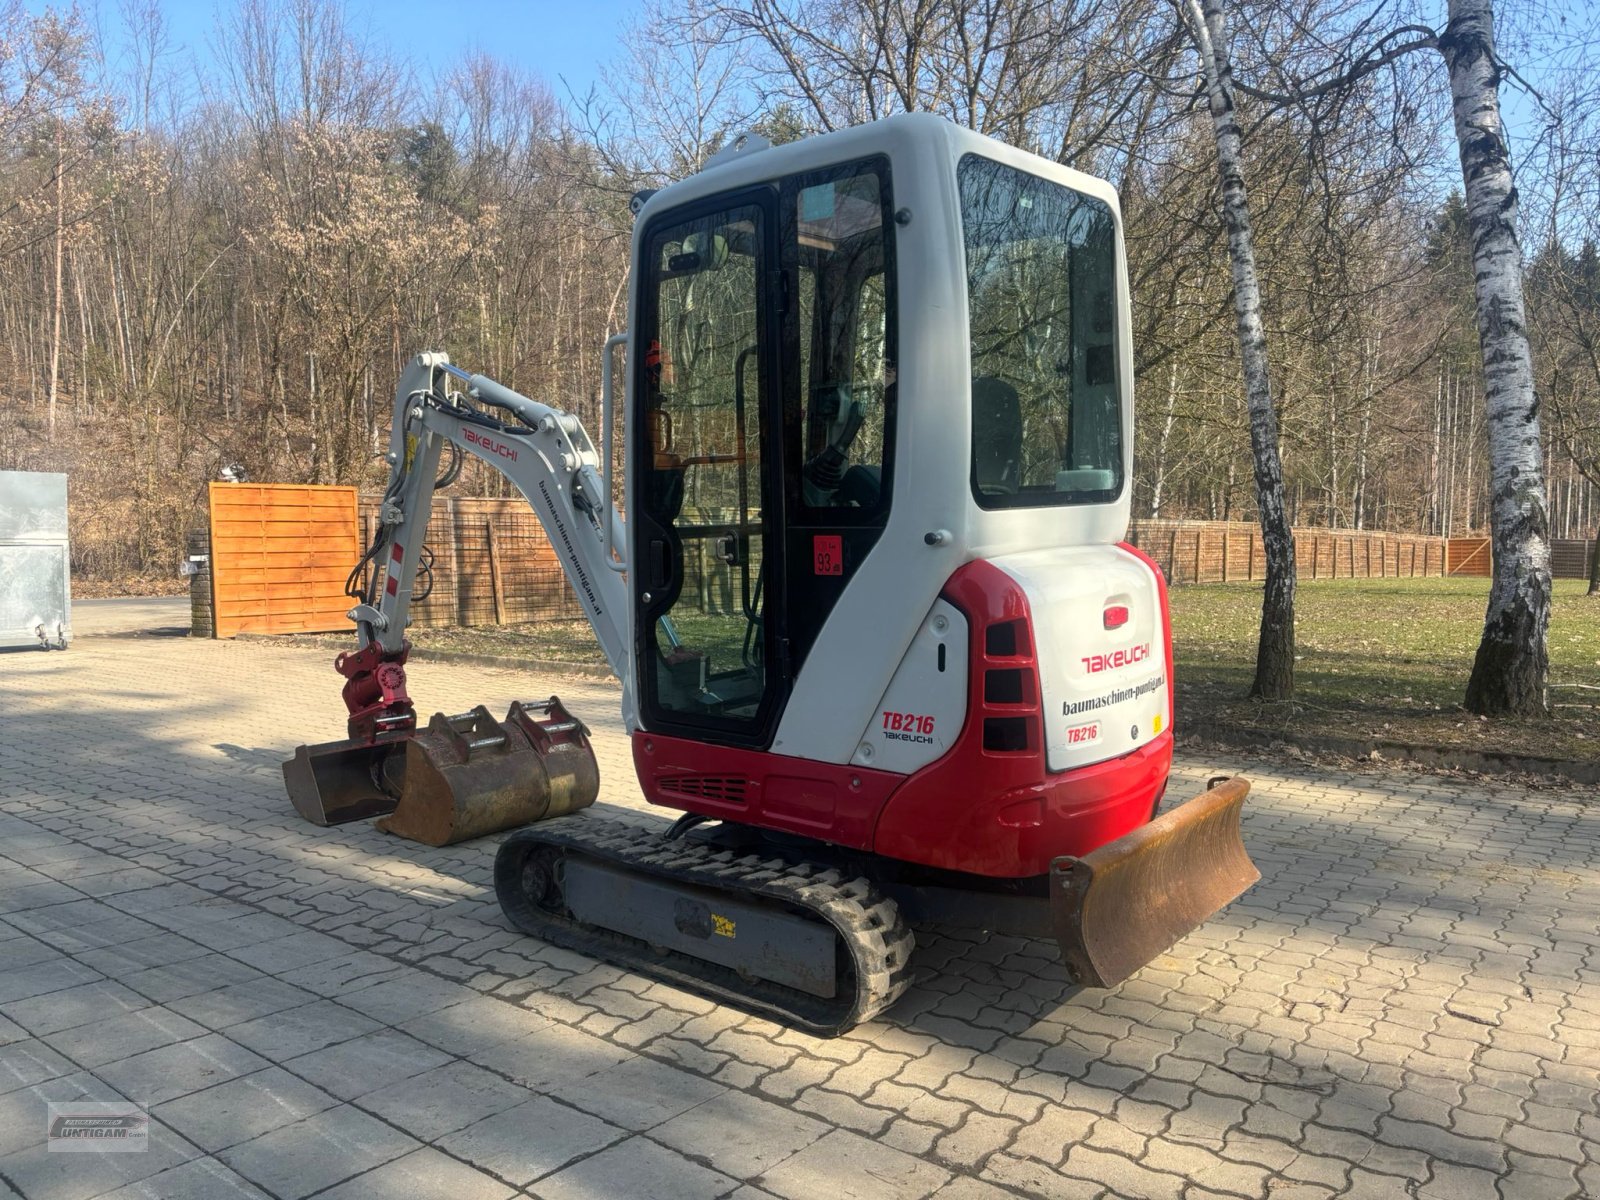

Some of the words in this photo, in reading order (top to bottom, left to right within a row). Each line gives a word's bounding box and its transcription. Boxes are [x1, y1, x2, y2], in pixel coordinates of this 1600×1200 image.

[462, 428, 518, 463] TAKEUCHI
[538, 480, 603, 616] baumaschinen-puntigam.at
[1081, 642, 1150, 674] TAKEUCHI
[882, 711, 936, 735] TB216
[1067, 725, 1098, 744] TB216
[882, 731, 934, 745] TAKEUCHI
